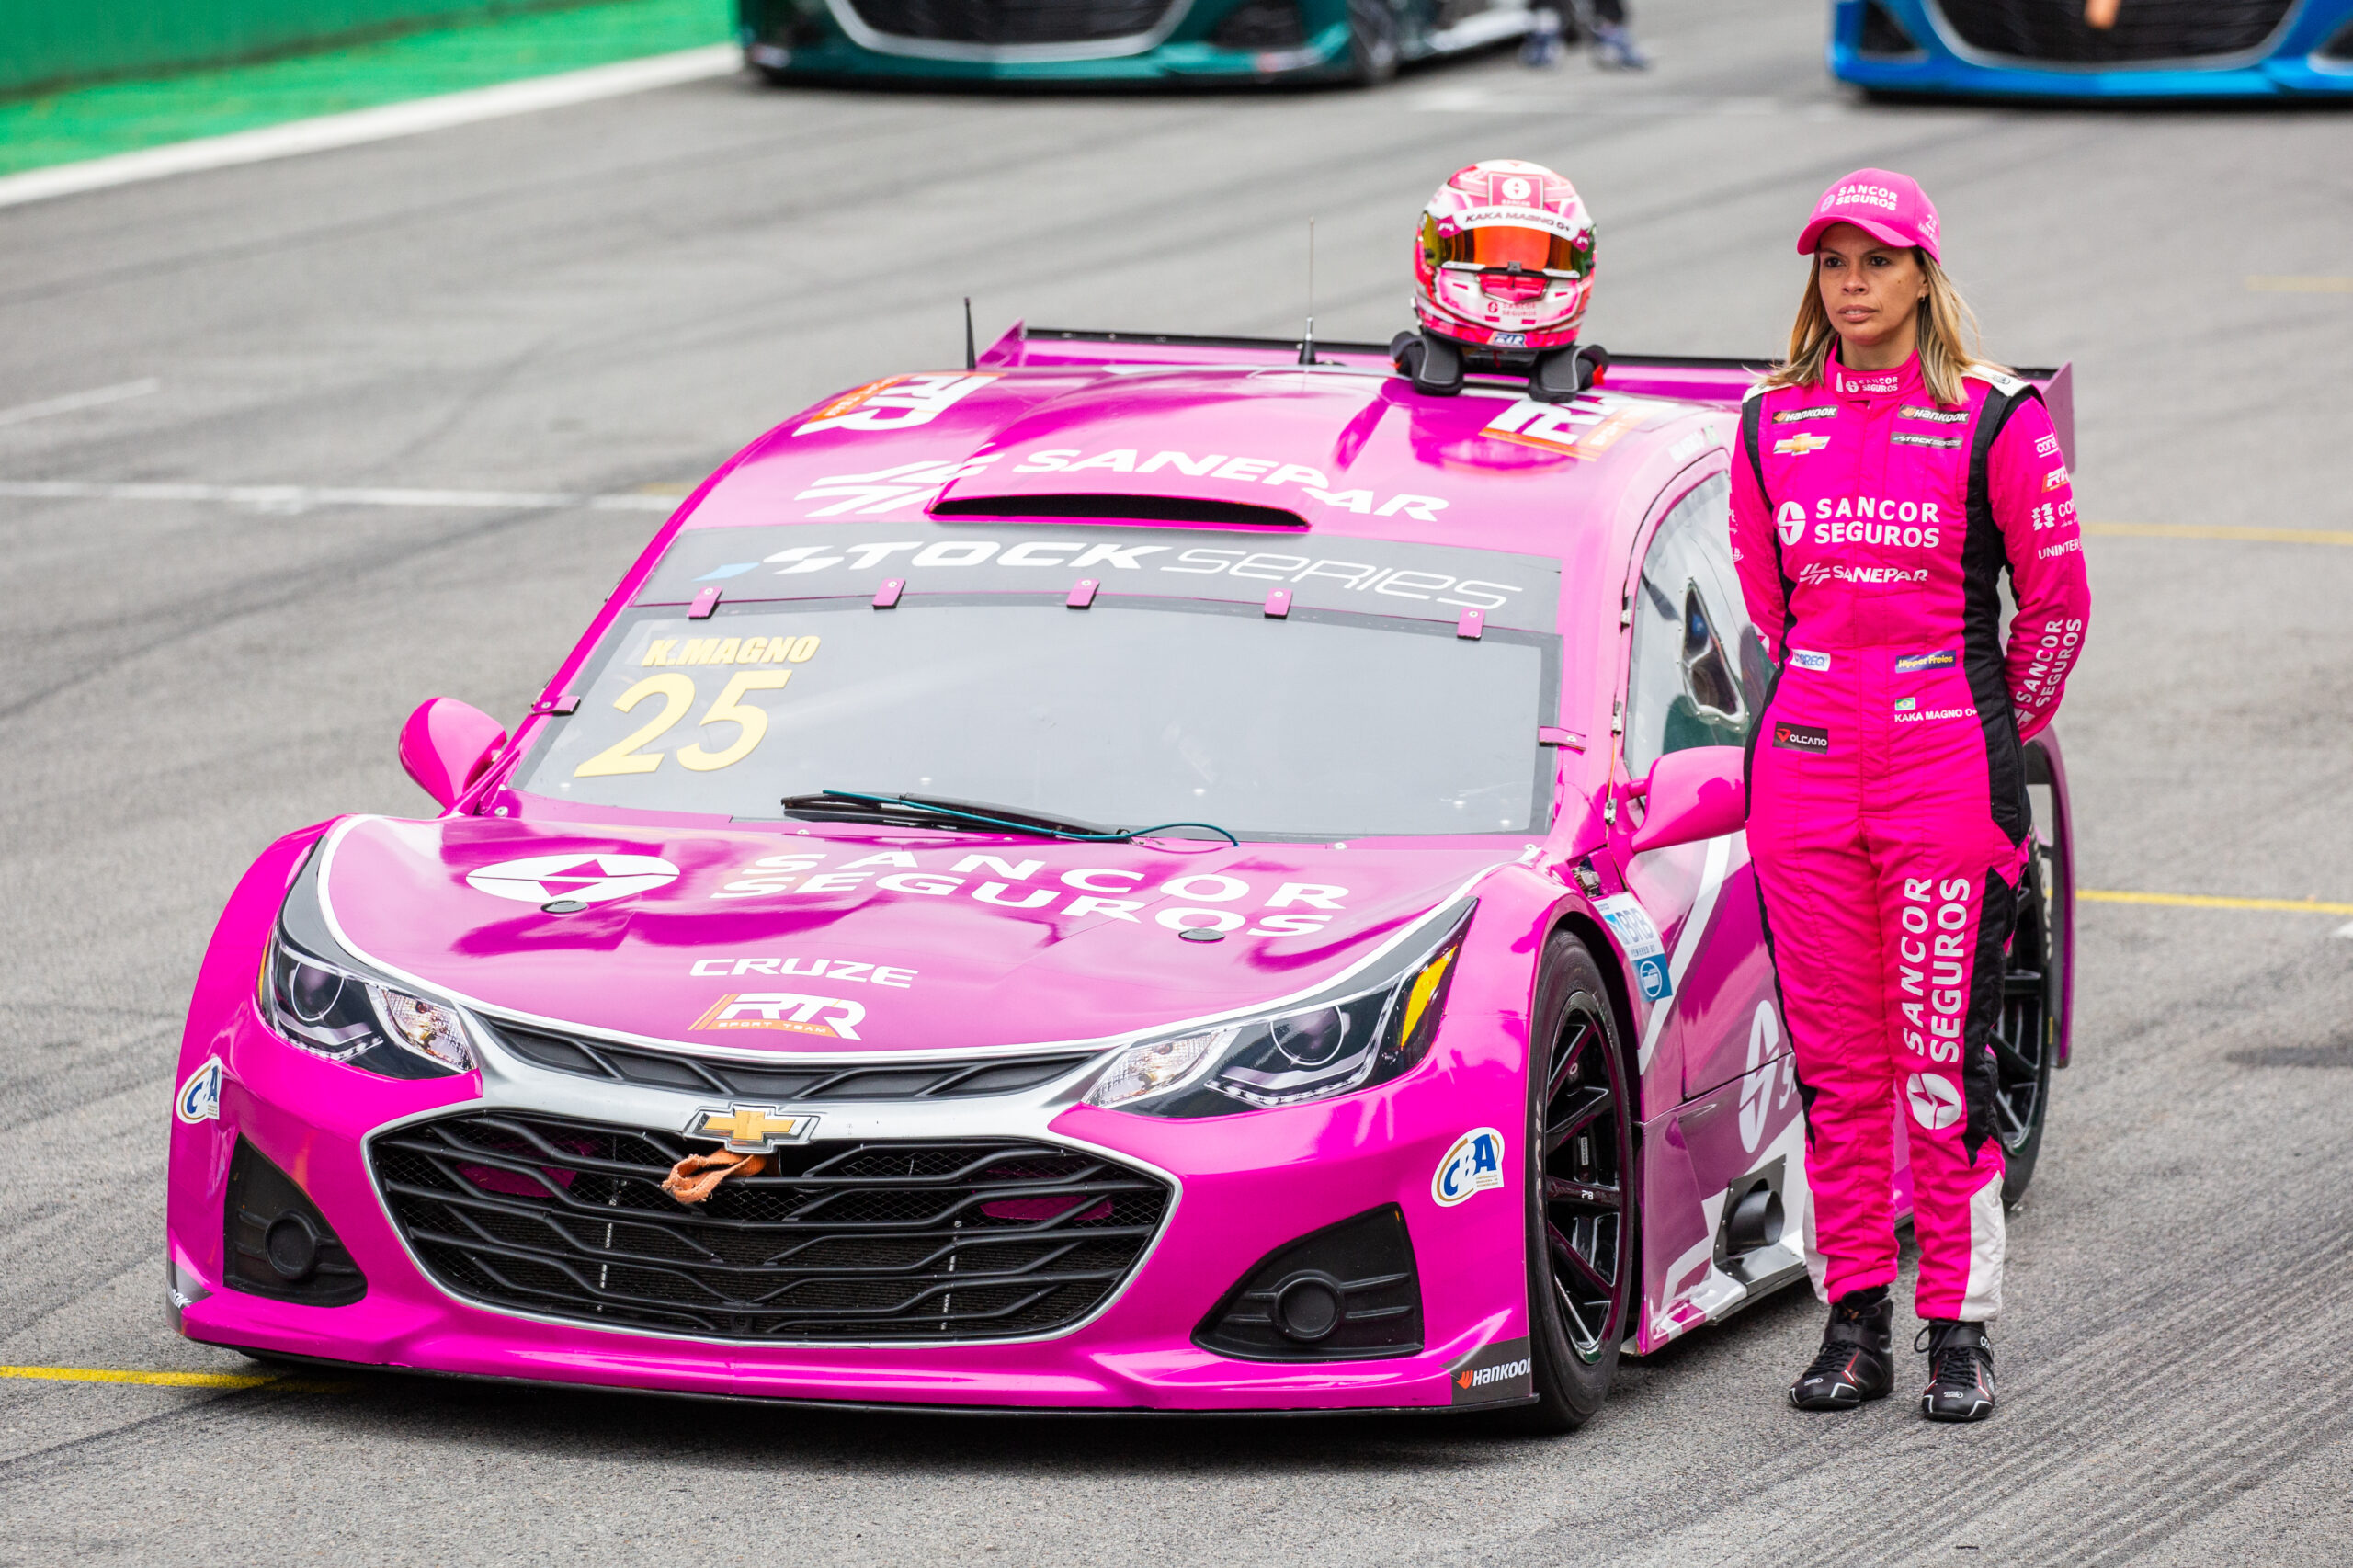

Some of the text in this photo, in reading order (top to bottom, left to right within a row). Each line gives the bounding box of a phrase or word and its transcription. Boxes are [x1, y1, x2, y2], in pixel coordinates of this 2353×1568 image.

[1836, 194, 1897, 211] SEGUROS
[1838, 184, 1898, 202] SANCOR
[1465, 212, 1503, 223] KAKA
[1506, 212, 1554, 226] MAGNO
[1859, 376, 1898, 385] SANCOR
[1861, 383, 1898, 393] SEGUROS
[1012, 449, 1449, 522] SANEPAR
[1816, 496, 1940, 523] SANCOR
[1814, 521, 1940, 548] SEGUROS
[762, 540, 1173, 575] STOCK
[1832, 565, 1928, 584] SANEPAR
[641, 635, 821, 667] K.MAGNO
[2015, 619, 2063, 704] SANCOR
[2035, 619, 2082, 708] SEGUROS
[574, 669, 792, 778] 25
[1894, 708, 1978, 723] KAKA MAGNO O+
[742, 851, 1349, 909] SANCOR
[710, 872, 1334, 937] SEGUROS
[689, 957, 919, 989] CRUZE
[1898, 877, 1932, 1057] SANCOR
[1929, 878, 1971, 1063] SEGUROS
[715, 992, 866, 1040] RTR
[718, 1020, 826, 1034] SPORT TEAM
